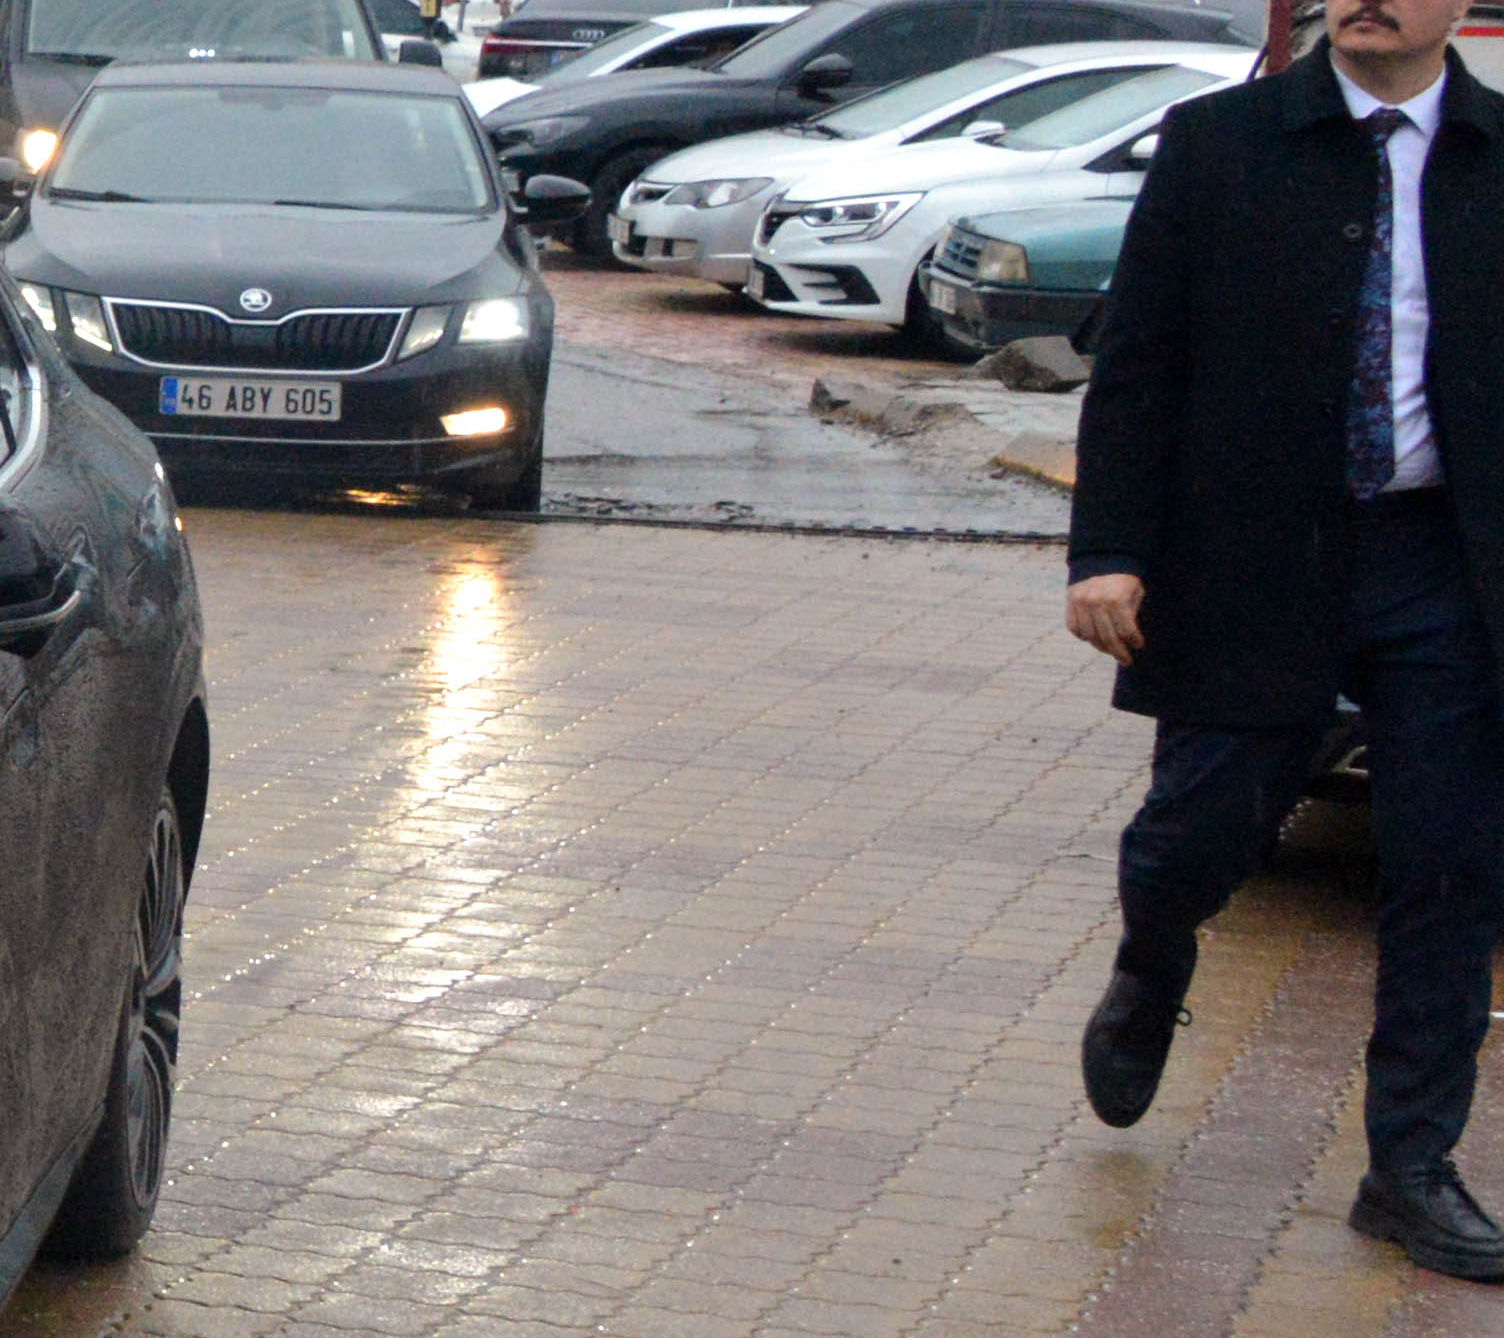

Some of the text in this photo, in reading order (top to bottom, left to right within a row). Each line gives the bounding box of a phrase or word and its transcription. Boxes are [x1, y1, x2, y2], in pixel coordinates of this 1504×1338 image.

[181, 383, 333, 415] 46 ABY 605
